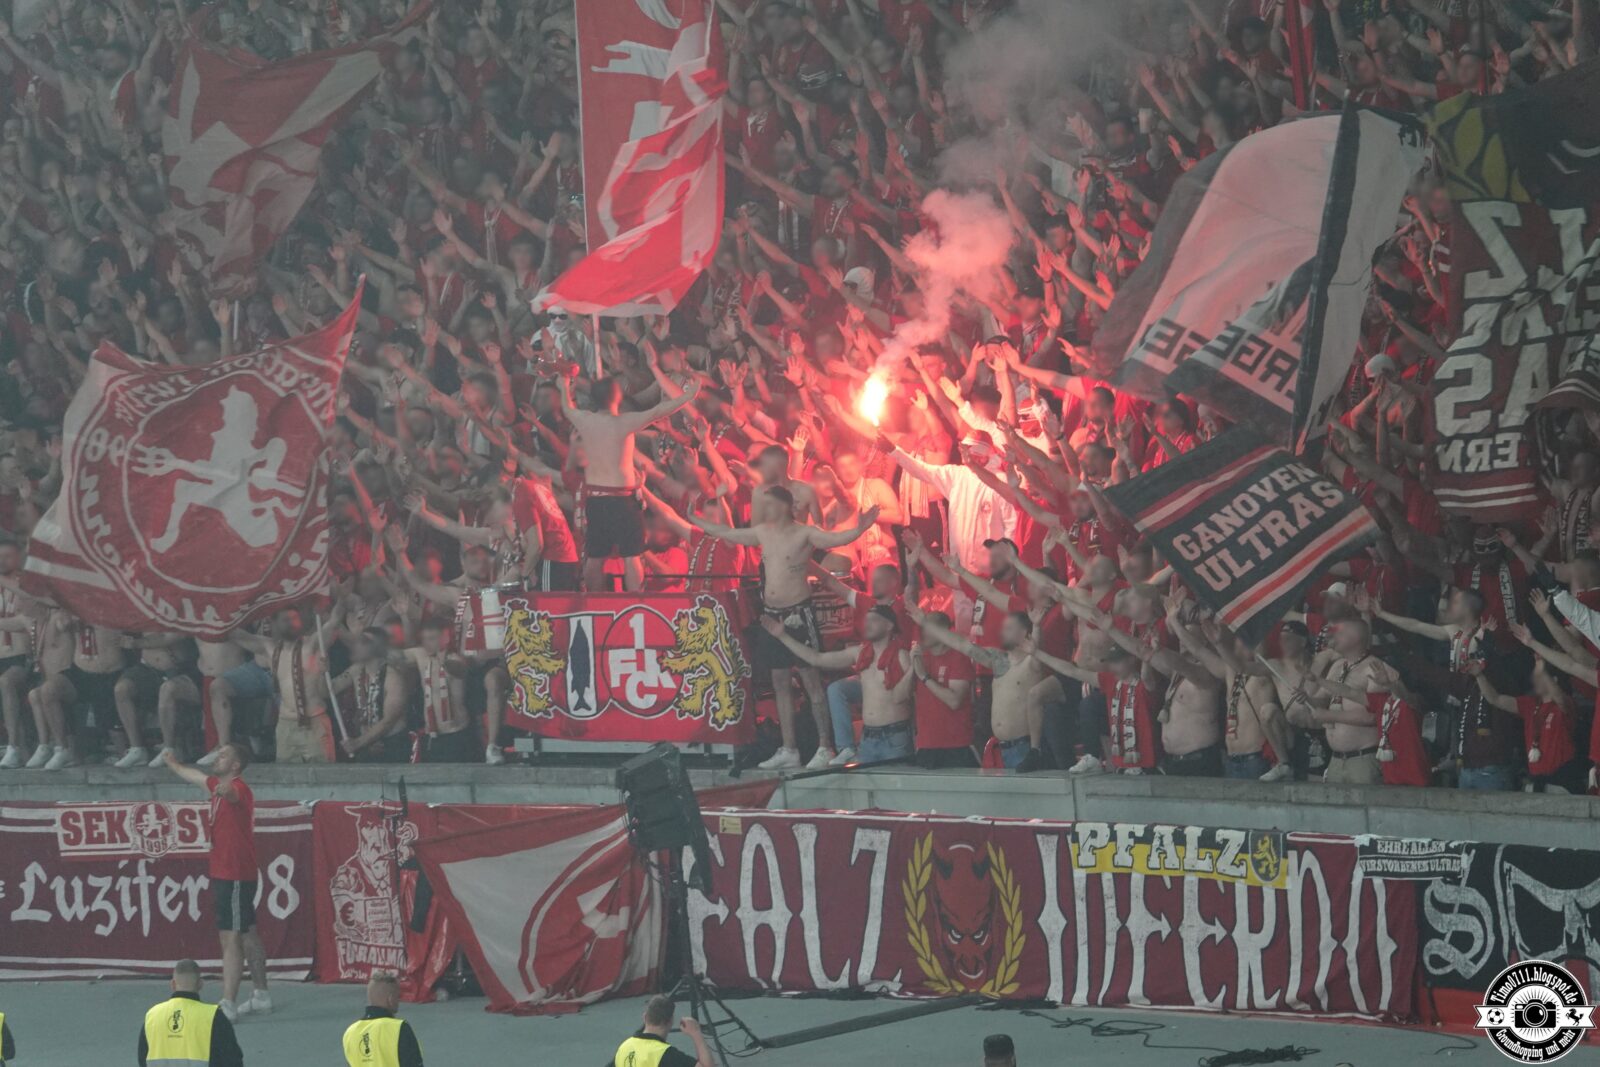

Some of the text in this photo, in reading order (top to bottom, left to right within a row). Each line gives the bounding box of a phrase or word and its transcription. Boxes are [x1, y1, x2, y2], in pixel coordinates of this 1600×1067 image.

[1172, 462, 1317, 562] GANOVEN
[1193, 480, 1345, 592] ULTRAS
[60, 810, 130, 846] SEK
[1074, 822, 1248, 878] PFALZ
[1377, 840, 1446, 855] EHRE ALLEN
[1430, 858, 1461, 873] ULTRAS
[11, 859, 210, 937] Luzifer
